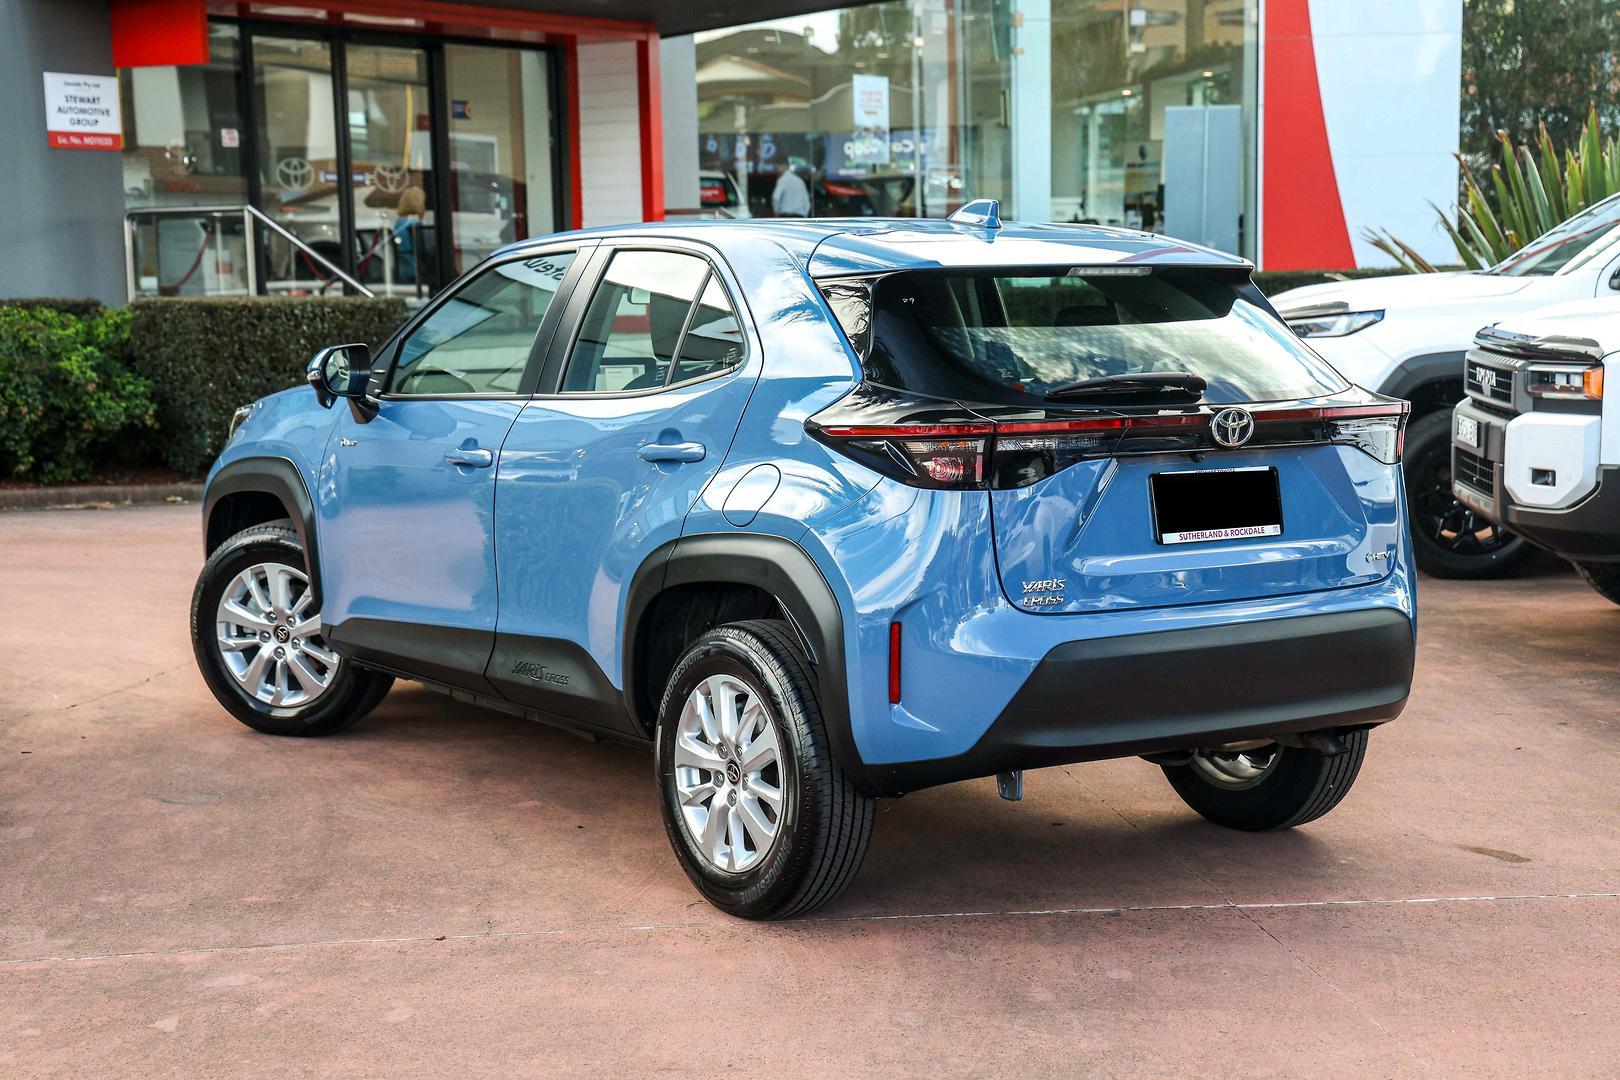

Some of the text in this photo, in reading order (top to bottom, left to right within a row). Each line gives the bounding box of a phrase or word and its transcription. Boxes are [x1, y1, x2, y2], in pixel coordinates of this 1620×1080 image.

[64, 94, 101, 104] STEWART
[57, 106, 110, 117] AUTOMOTIVE
[69, 118, 99, 126] GROUP
[1475, 366, 1497, 387] TOYOTA
[1179, 529, 1224, 541] SUTHERLAND
[1224, 528, 1229, 540] &
[1230, 526, 1265, 537] ROCKDALE
[1022, 579, 1066, 593] YARIS
[1023, 595, 1064, 607] CROSS
[512, 659, 570, 685] YARIS CROSS
